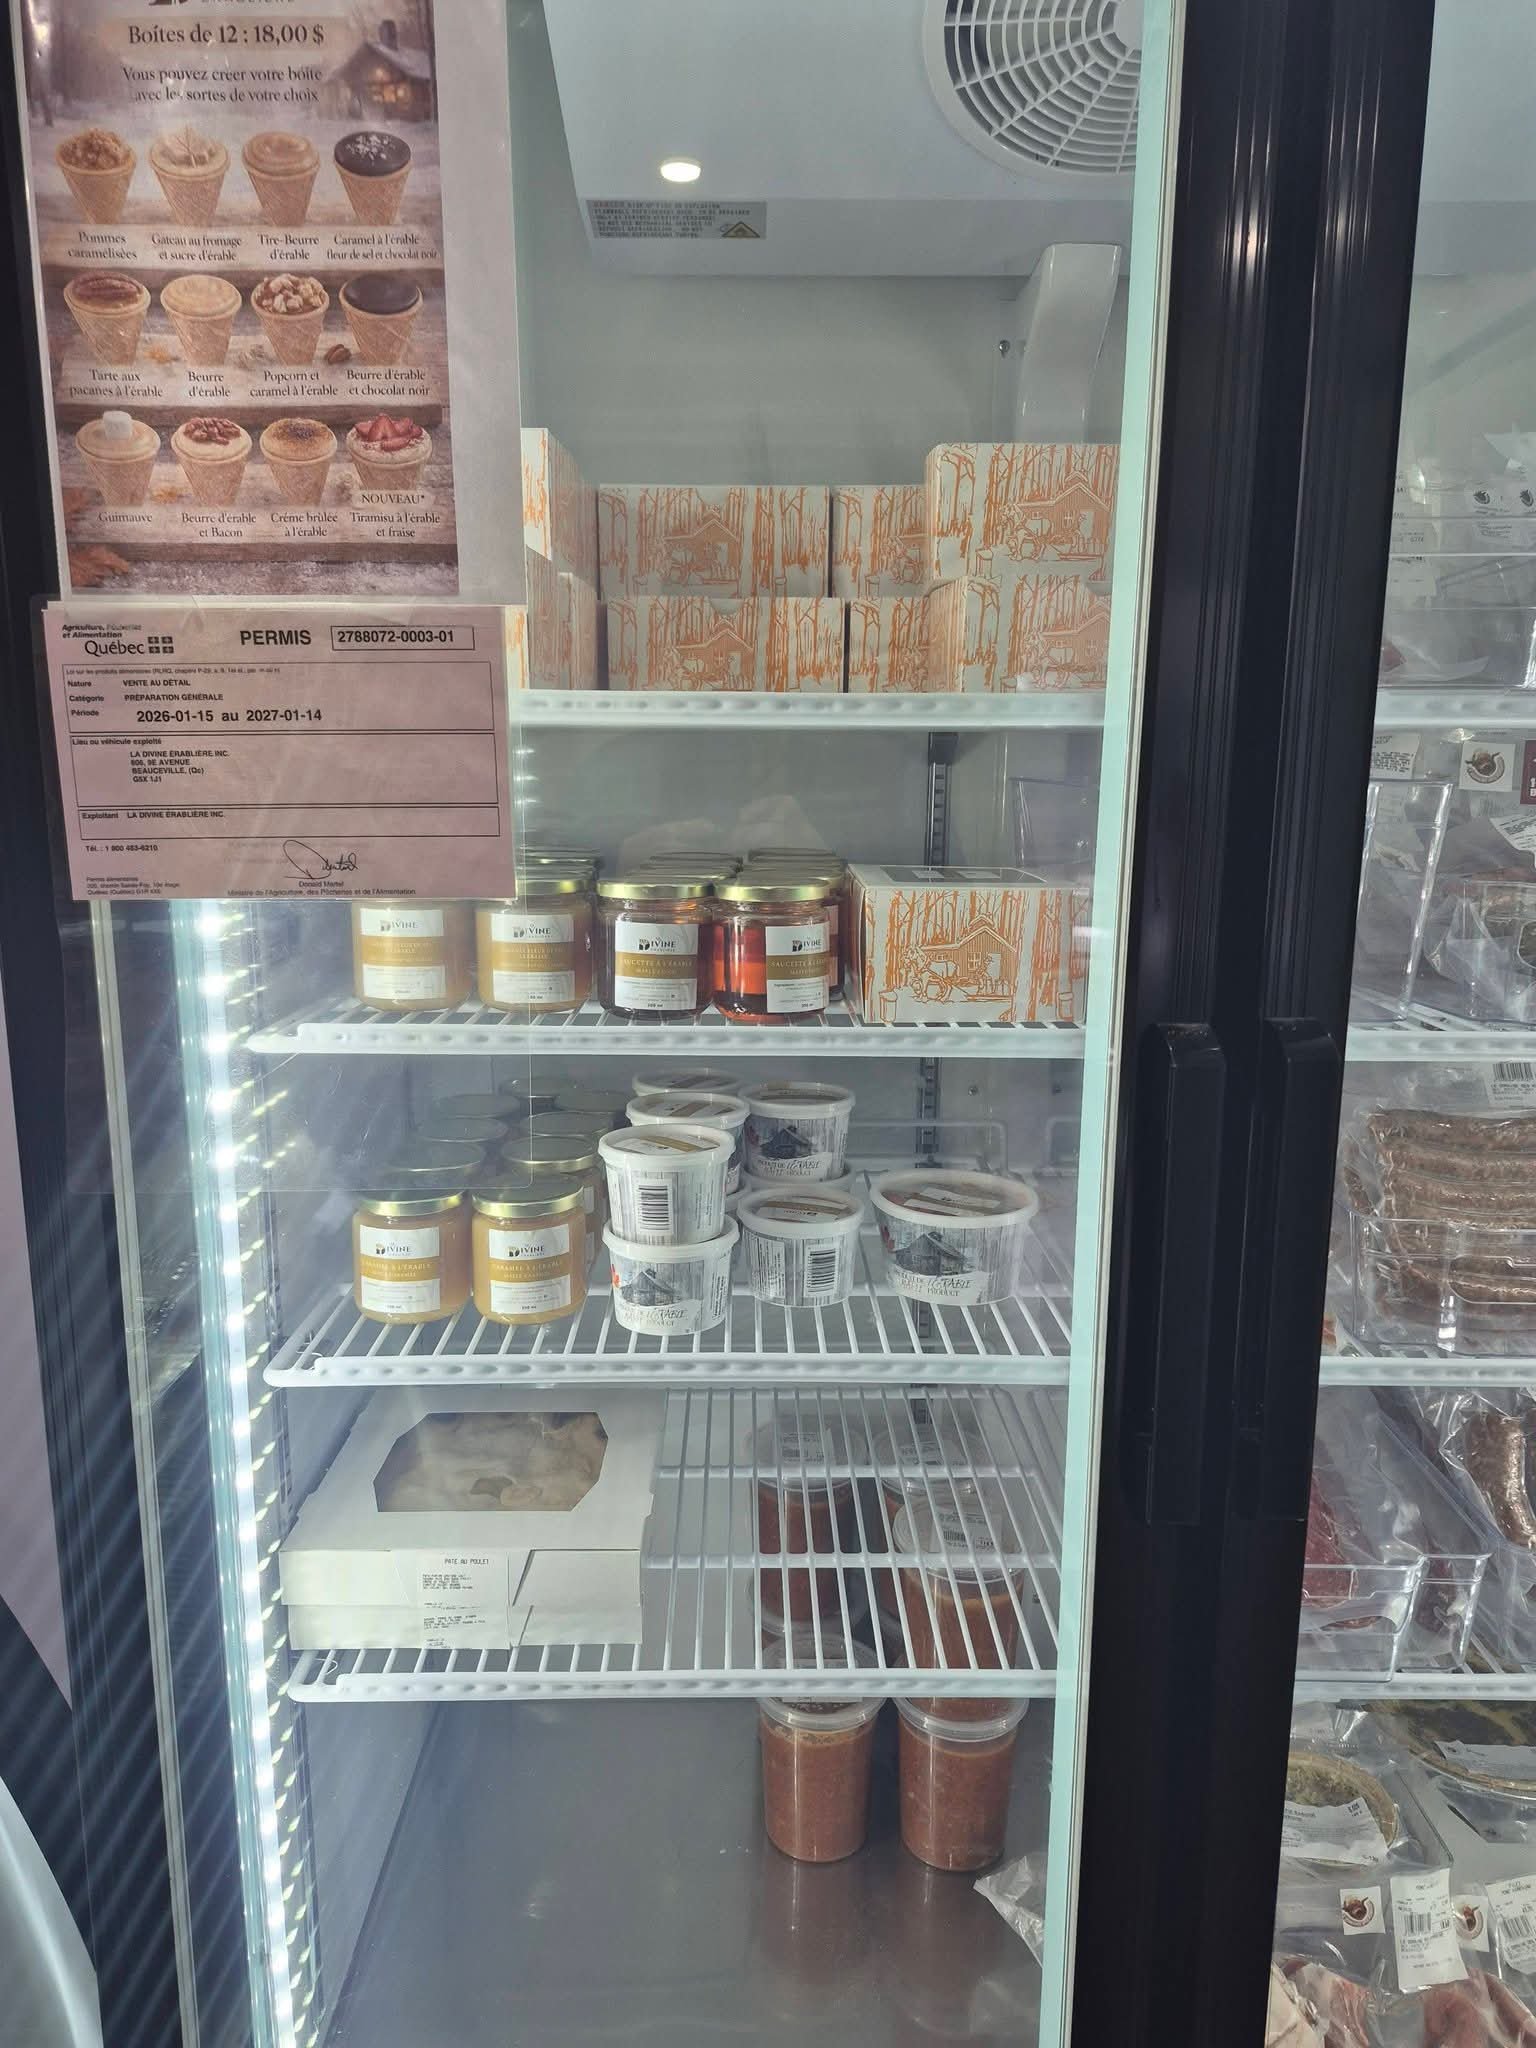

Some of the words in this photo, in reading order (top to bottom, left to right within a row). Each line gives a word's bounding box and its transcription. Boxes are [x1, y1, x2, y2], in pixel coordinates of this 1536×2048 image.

[190, 24, 212, 44] de
[219, 25, 238, 43] 12
[254, 24, 307, 46] 18,00
[312, 24, 324, 45] $
[122, 66, 155, 81] Vous
[159, 69, 207, 84] pouvez
[250, 69, 284, 81] votre
[136, 90, 162, 101] avec
[187, 88, 226, 101] sortes
[229, 87, 246, 101] de
[250, 89, 280, 101] votre
[284, 87, 318, 101] choix
[78, 231, 126, 244] Pommes
[189, 235, 200, 246] au
[202, 234, 242, 248] fromage
[334, 233, 375, 245] Caramel
[159, 251, 169, 260] et
[171, 252, 196, 261] sucre
[270, 249, 310, 260] d'érable
[327, 249, 346, 260] fleur
[350, 250, 360, 260] de
[362, 250, 374, 260] sel
[385, 249, 419, 260] chocolat
[421, 250, 437, 260] noir
[89, 369, 118, 382] Tarte
[121, 373, 141, 382] aux
[188, 371, 224, 382] Beurre
[264, 371, 307, 384] Popcorn
[310, 372, 319, 381] et
[347, 370, 382, 380] Beurre
[385, 369, 426, 380] d'érable
[70, 386, 113, 397] pacanes
[116, 386, 122, 397] à
[125, 385, 163, 397] l'érable
[189, 386, 230, 397] d'érable
[250, 386, 290, 397] caramel
[293, 386, 299, 396] à
[301, 385, 338, 396] l'érable
[349, 386, 358, 395] et
[361, 385, 405, 395] chocolat
[408, 386, 430, 395] noir
[98, 512, 153, 523] Guimauve
[182, 513, 215, 523] Beurre
[218, 512, 256, 523] d'érable
[350, 512, 394, 523] Tiramisu
[397, 512, 403, 523] à
[404, 511, 440, 523] l'érable
[199, 528, 208, 537] et
[212, 527, 243, 537] Bacon
[285, 527, 290, 537] à
[292, 527, 328, 537] l'érable
[376, 528, 386, 537] et
[388, 527, 415, 538] fraise
[240, 630, 312, 645] PERMIS
[337, 630, 454, 643] 2788072-0003-01
[84, 640, 145, 657] Québec
[123, 679, 148, 687] VENTE
[150, 679, 161, 687] AU
[69, 695, 104, 703] Catégorie
[71, 708, 99, 716] Période
[136, 710, 214, 722] 2026-01-15
[221, 712, 239, 722] au
[246, 709, 322, 721] 2027-01-14
[133, 738, 161, 746] exploité
[82, 812, 119, 820] Exploitant
[139, 811, 164, 819] DIVINE
[210, 810, 225, 818] INC.
[299, 880, 322, 888] Donald
